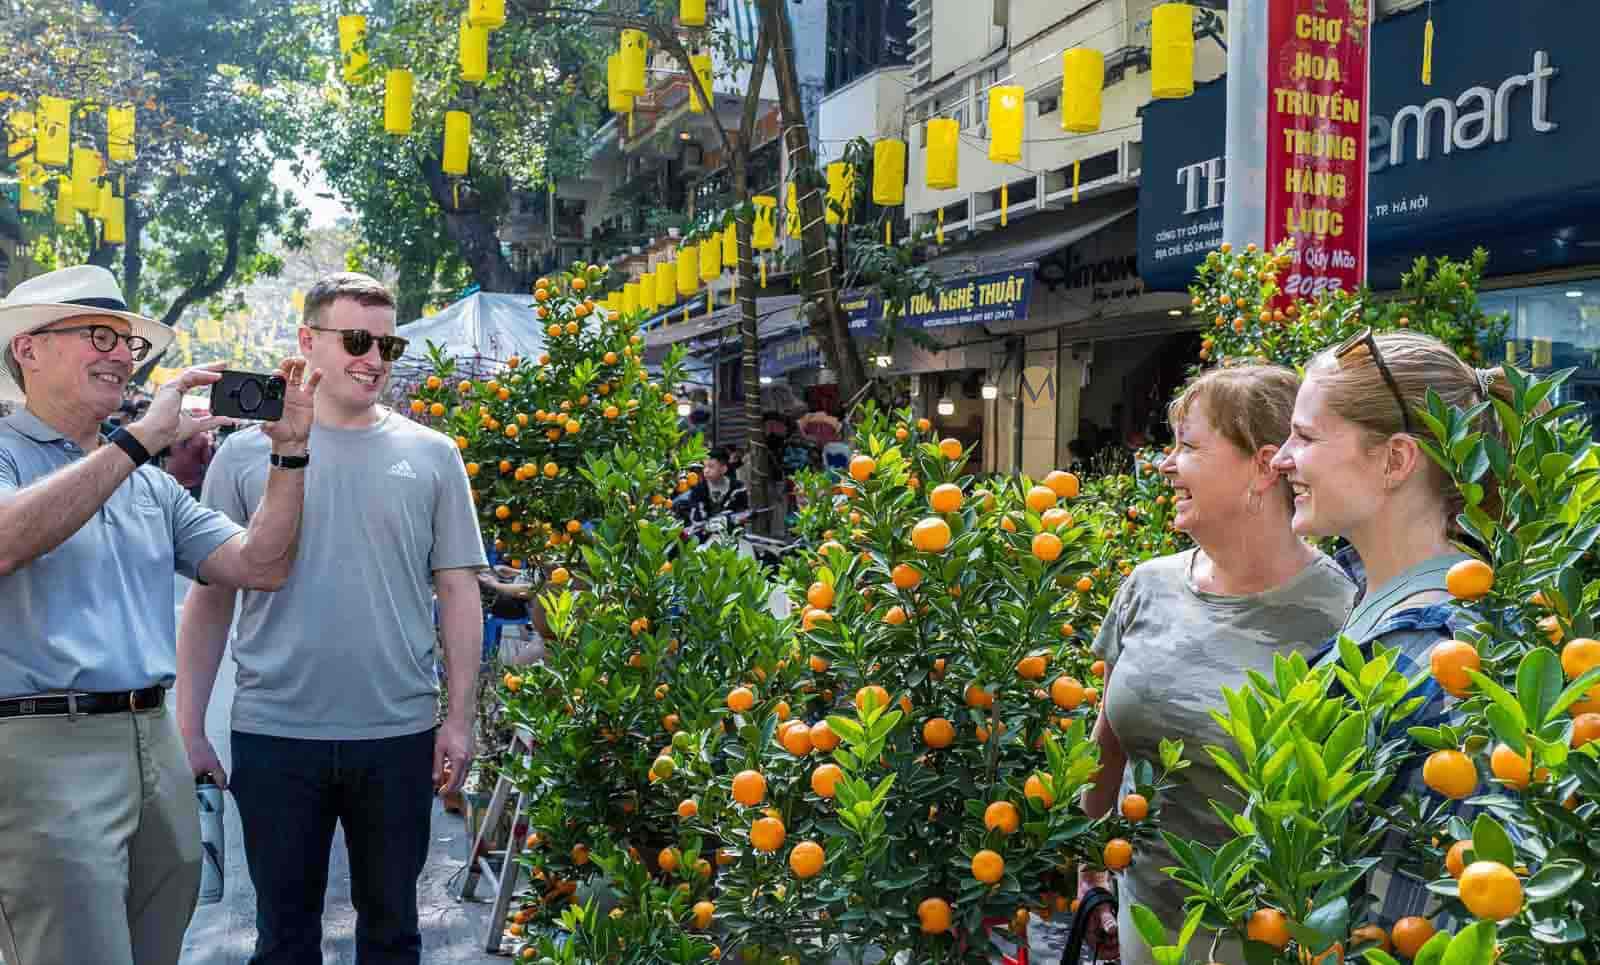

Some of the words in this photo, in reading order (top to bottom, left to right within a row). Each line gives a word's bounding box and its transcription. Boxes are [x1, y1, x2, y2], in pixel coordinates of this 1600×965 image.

[1295, 14, 1344, 49] CHỢ
[1295, 52, 1340, 82] HOA
[1392, 196, 1408, 214] HÀ
[1409, 193, 1429, 213] NỘI
[1176, 227, 1186, 240] TY
[1286, 207, 1345, 241] LƯỢC
[978, 274, 1025, 308] THUẬT
